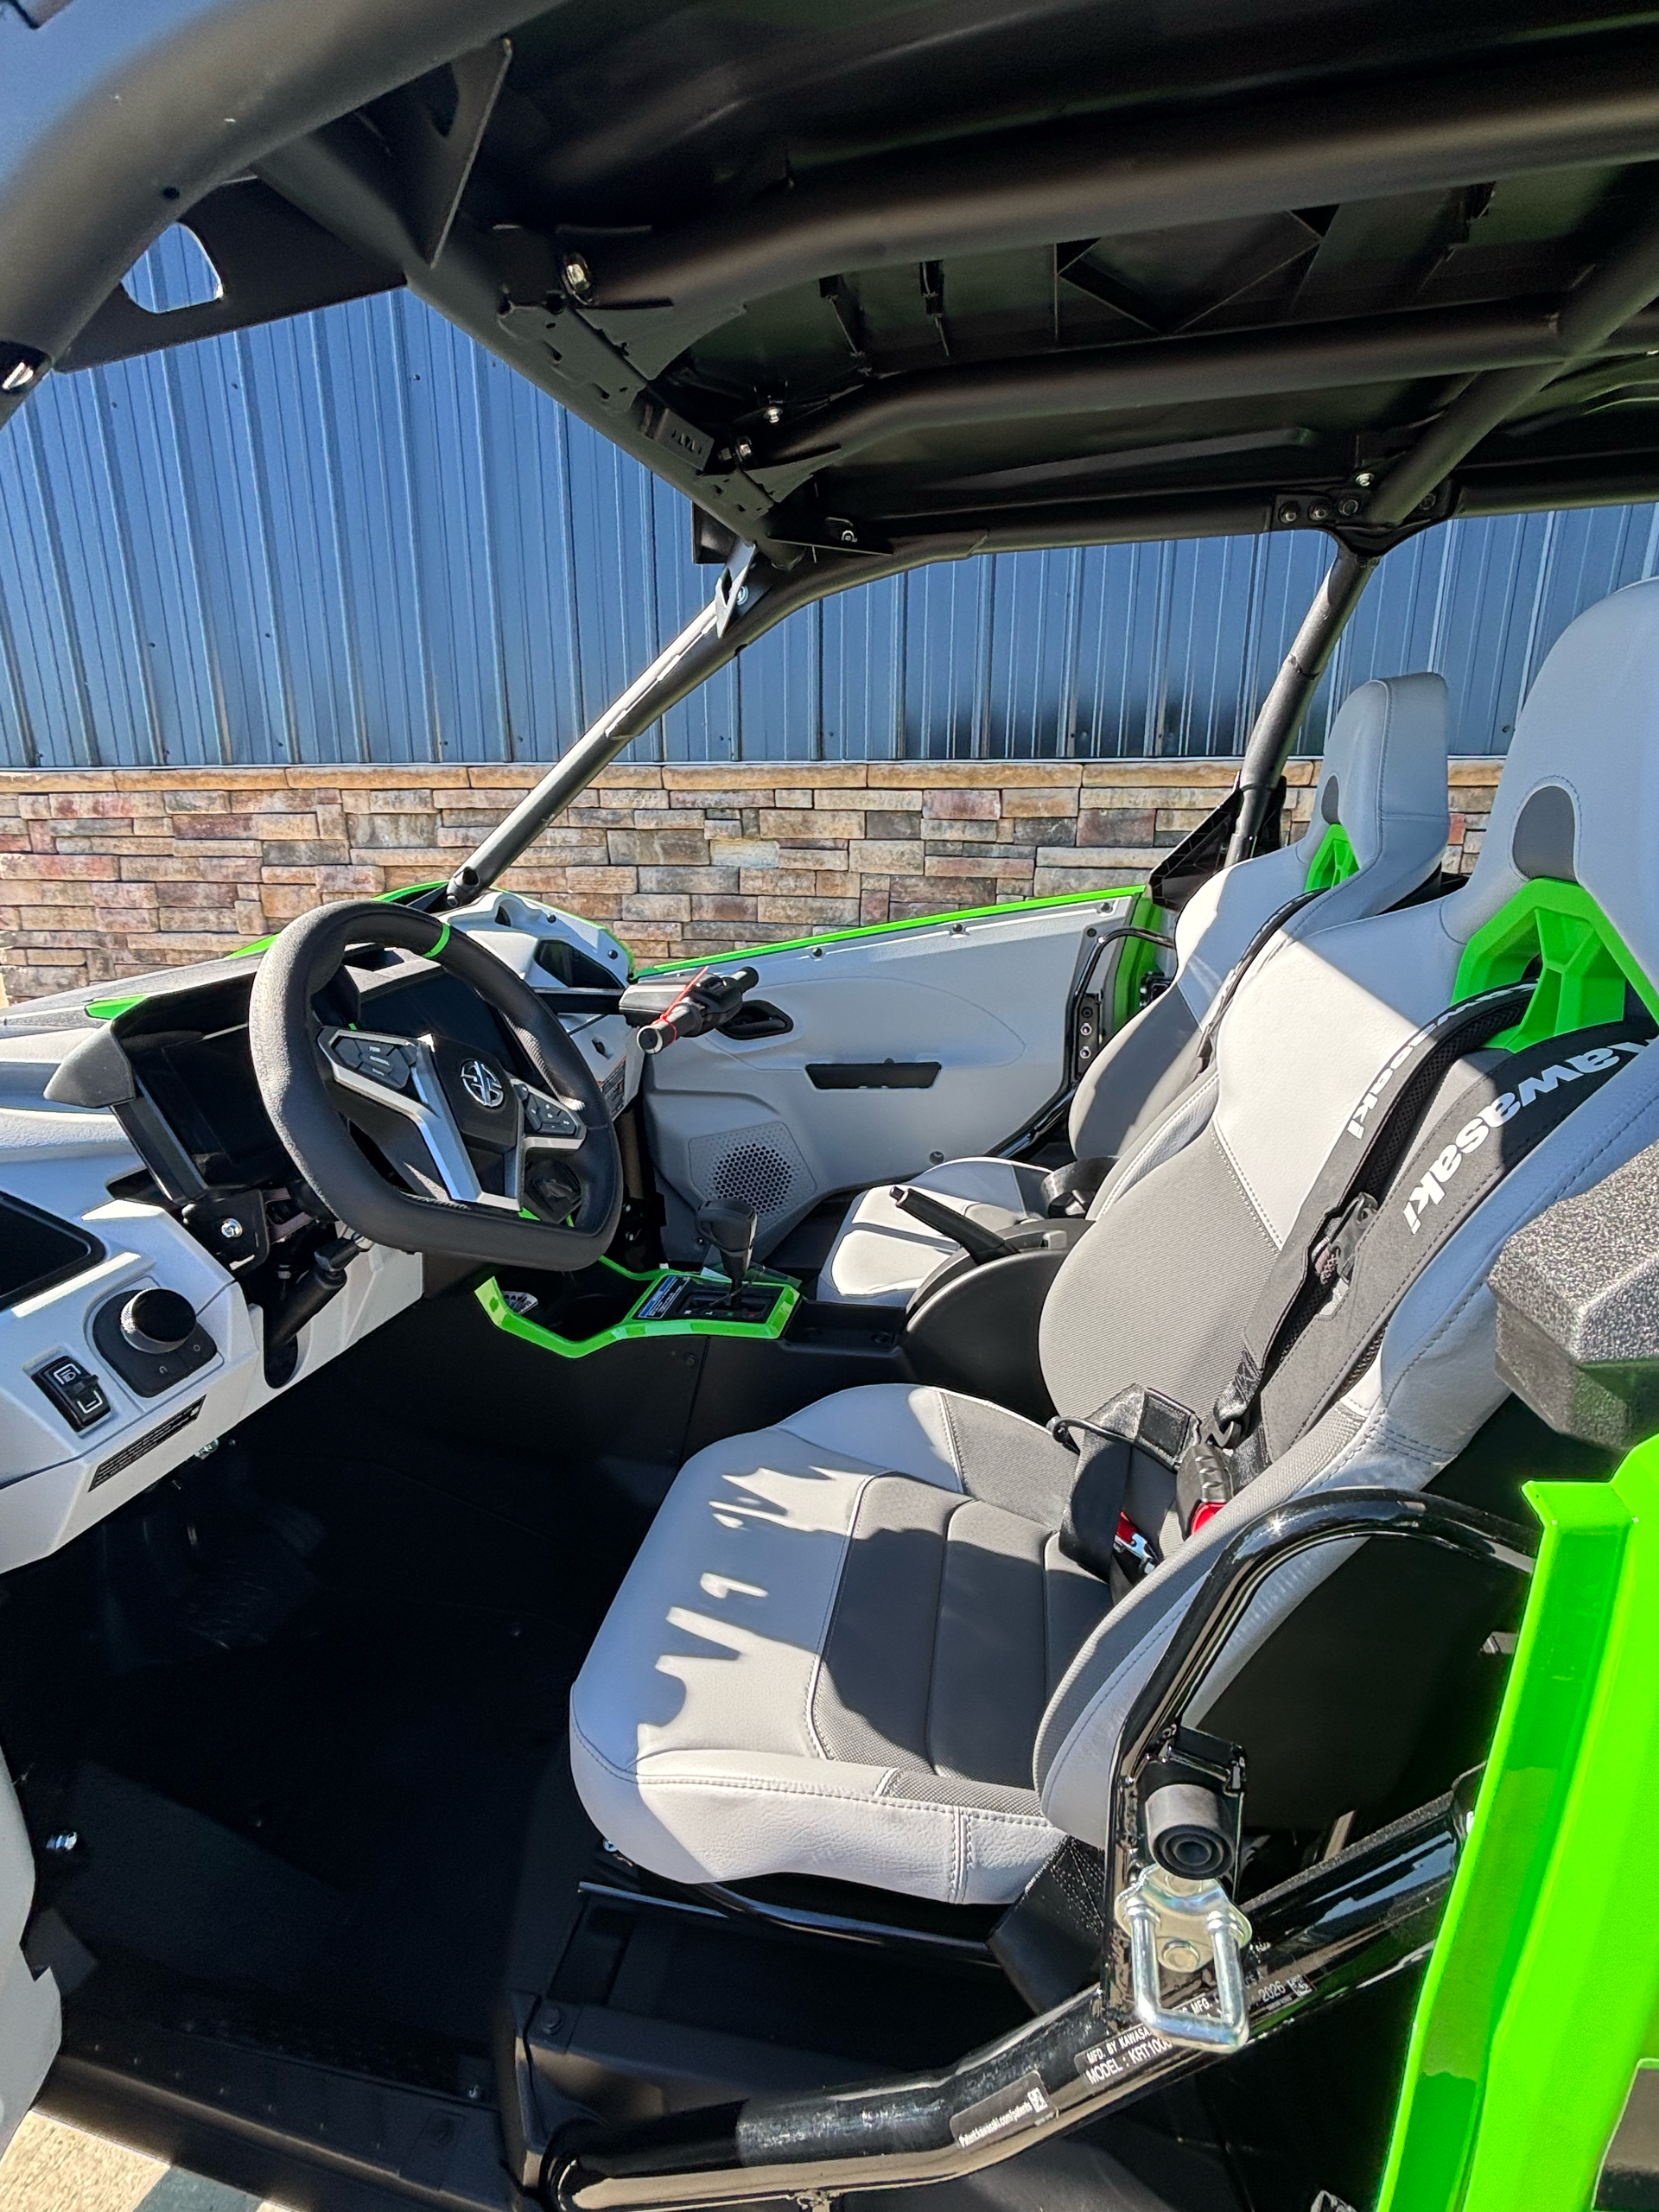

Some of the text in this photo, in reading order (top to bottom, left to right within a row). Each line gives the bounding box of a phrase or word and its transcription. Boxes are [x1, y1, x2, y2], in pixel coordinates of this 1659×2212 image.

[1085, 2058, 1122, 2085] MODEL
[1258, 1980, 1286, 2002] 2026
[1086, 2047, 1106, 2064] MFD.
[1106, 2040, 1117, 2055] BY
[1118, 2025, 1152, 2049] KAWASA
[1191, 1997, 1213, 2014] MFG.
